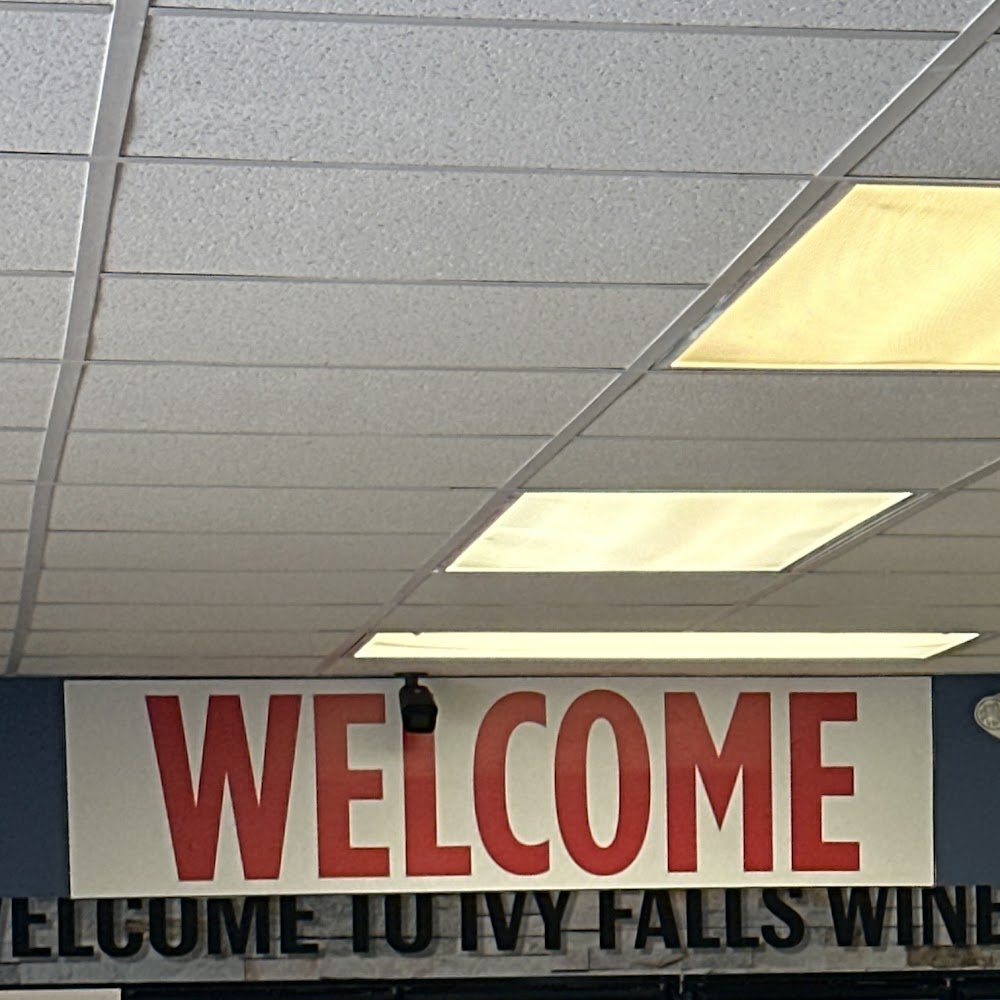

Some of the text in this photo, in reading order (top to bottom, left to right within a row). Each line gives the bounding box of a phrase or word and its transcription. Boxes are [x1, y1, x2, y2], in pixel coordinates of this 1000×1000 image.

[145, 690, 861, 881] WELCOME
[461, 891, 570, 951] IVY
[599, 888, 804, 949] FALLS
